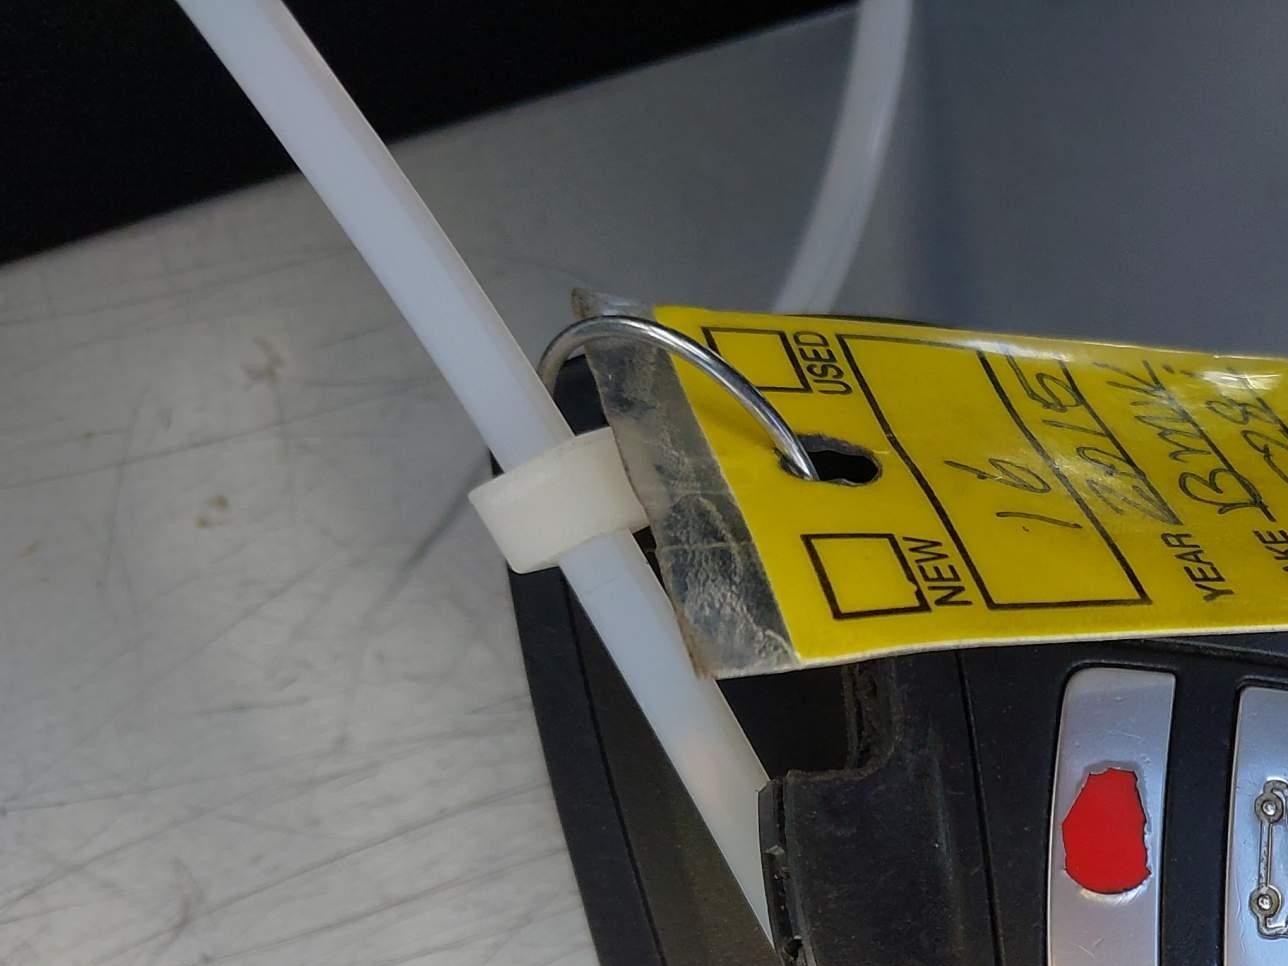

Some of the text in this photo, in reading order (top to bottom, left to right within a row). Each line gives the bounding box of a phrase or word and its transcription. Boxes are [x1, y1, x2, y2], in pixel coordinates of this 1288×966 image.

[798, 330, 851, 396] USED
[903, 536, 972, 606] NEW
[1160, 531, 1236, 603] YEAR
